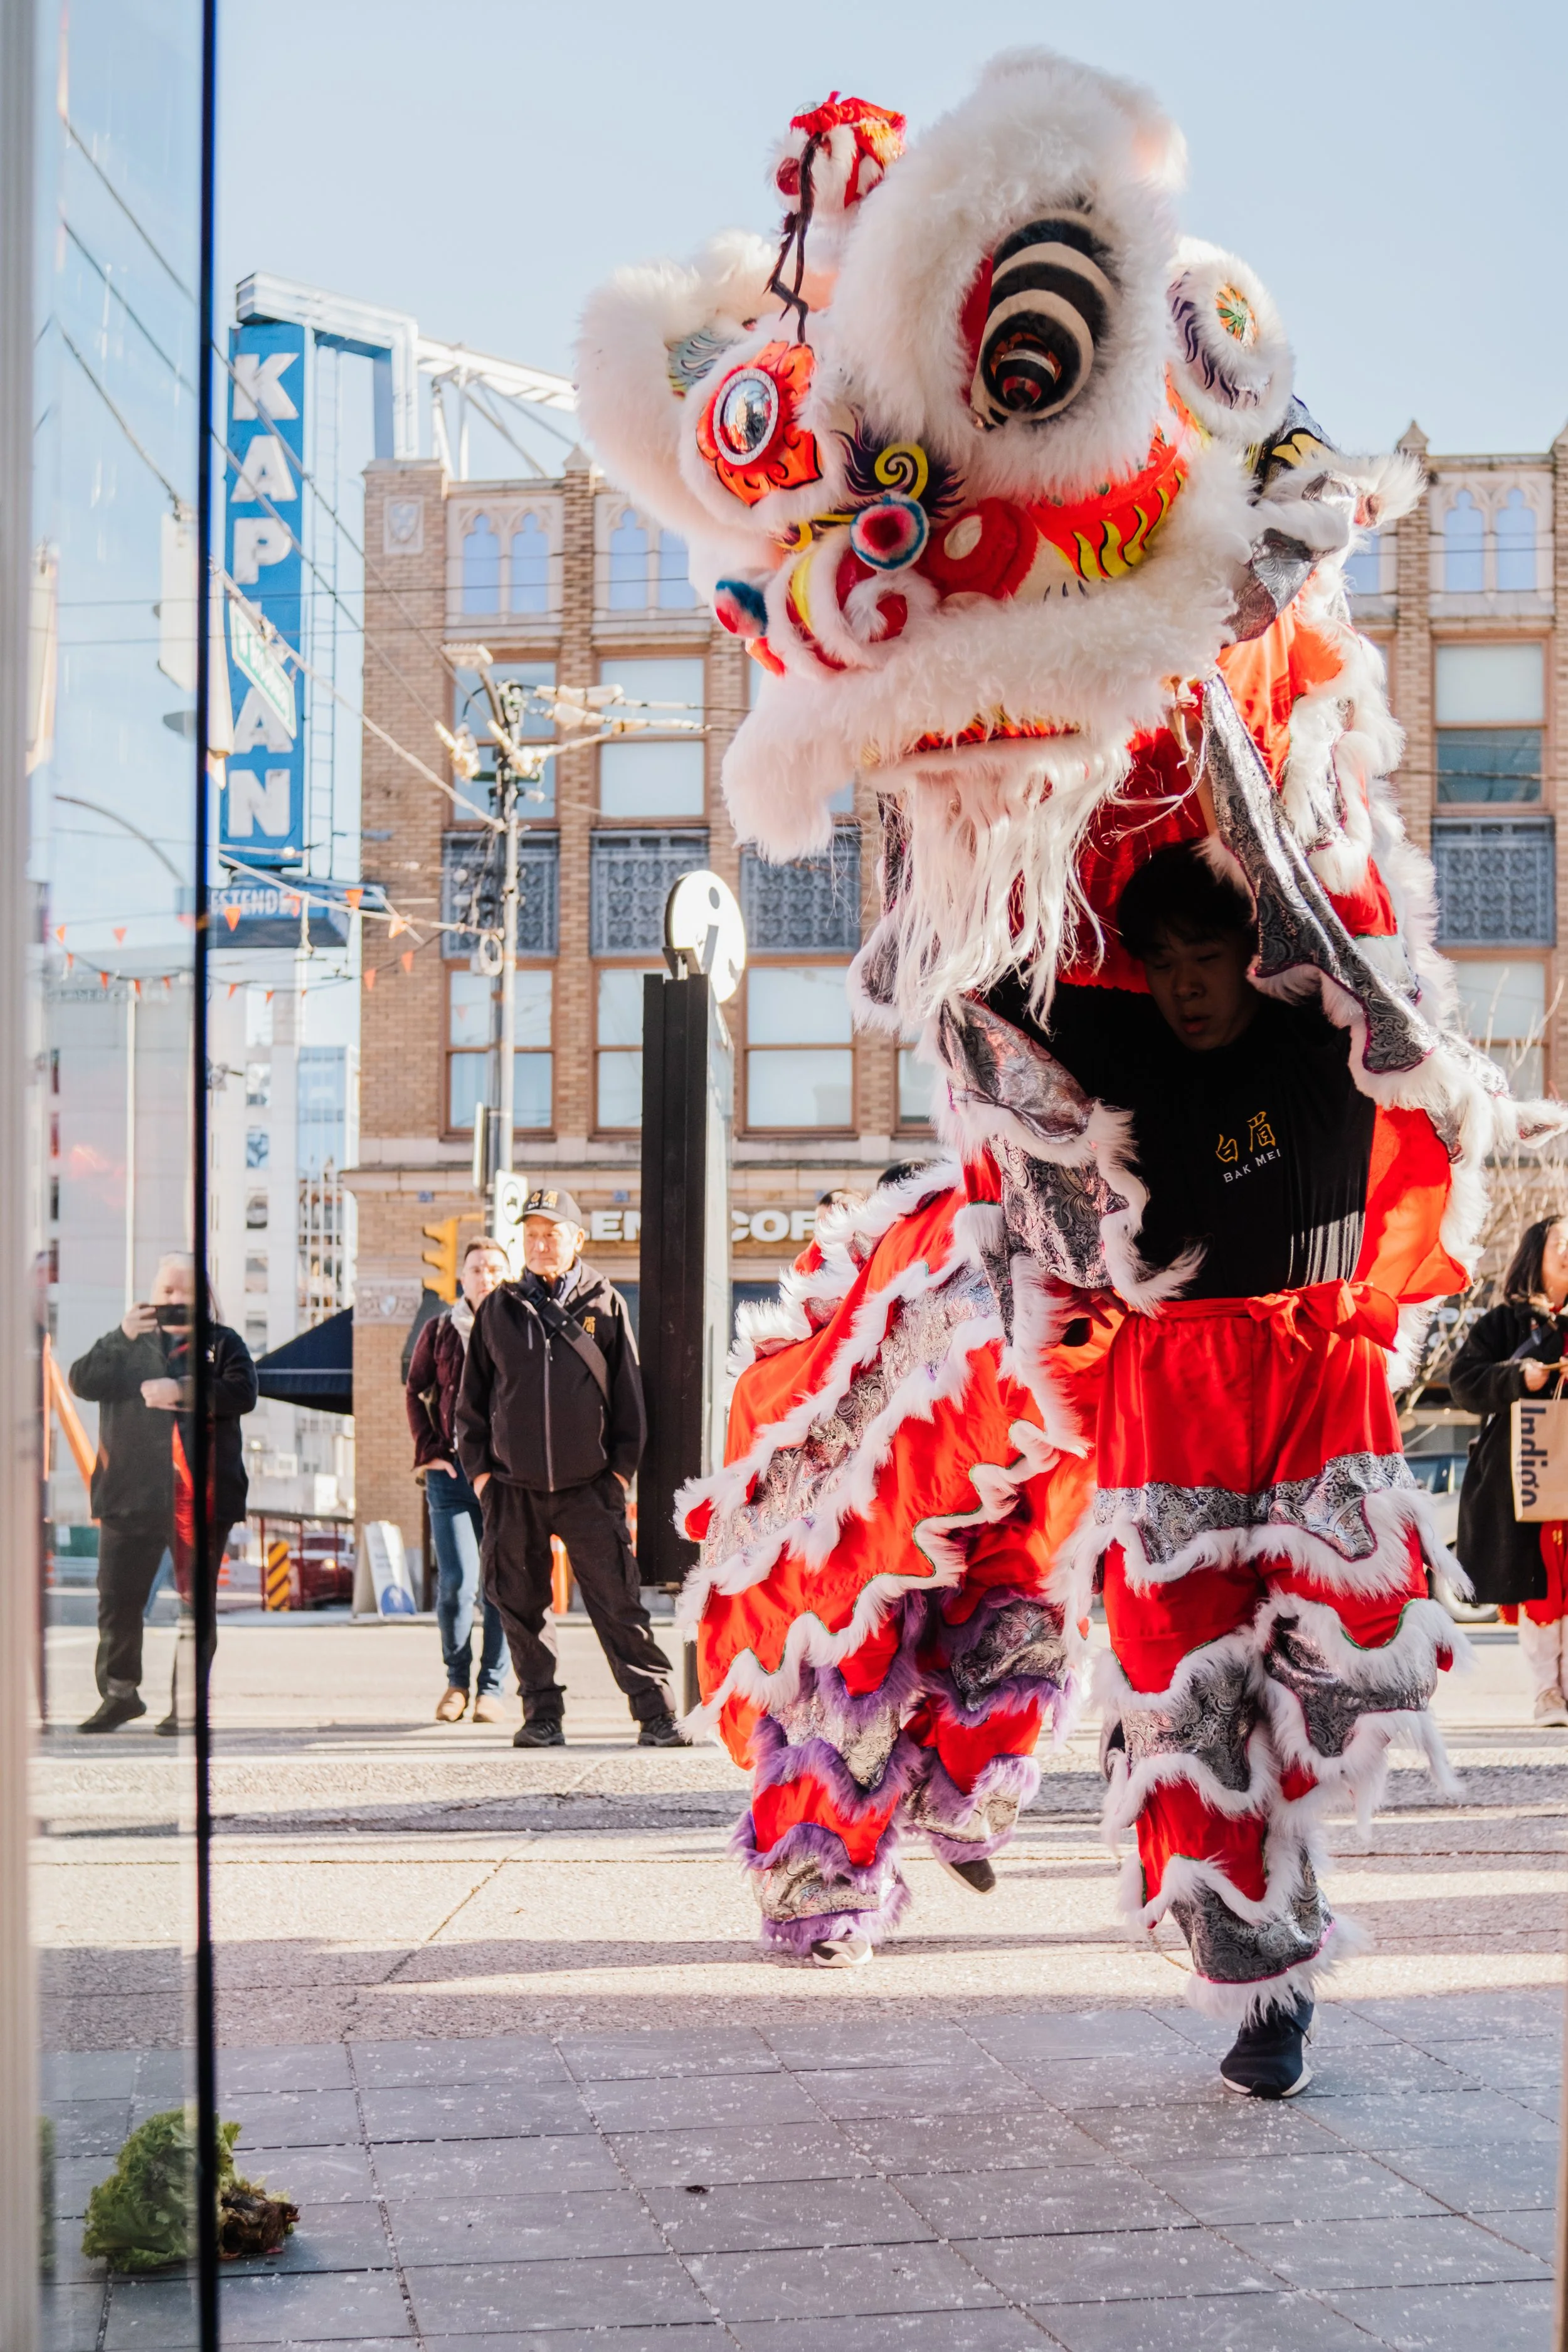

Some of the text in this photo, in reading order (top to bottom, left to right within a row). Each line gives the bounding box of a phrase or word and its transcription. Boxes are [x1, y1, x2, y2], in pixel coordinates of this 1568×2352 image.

[227, 352, 300, 837] KAPAN
[1215, 1111, 1276, 1163] 白眉
[1223, 1148, 1281, 1183] BAK MEI
